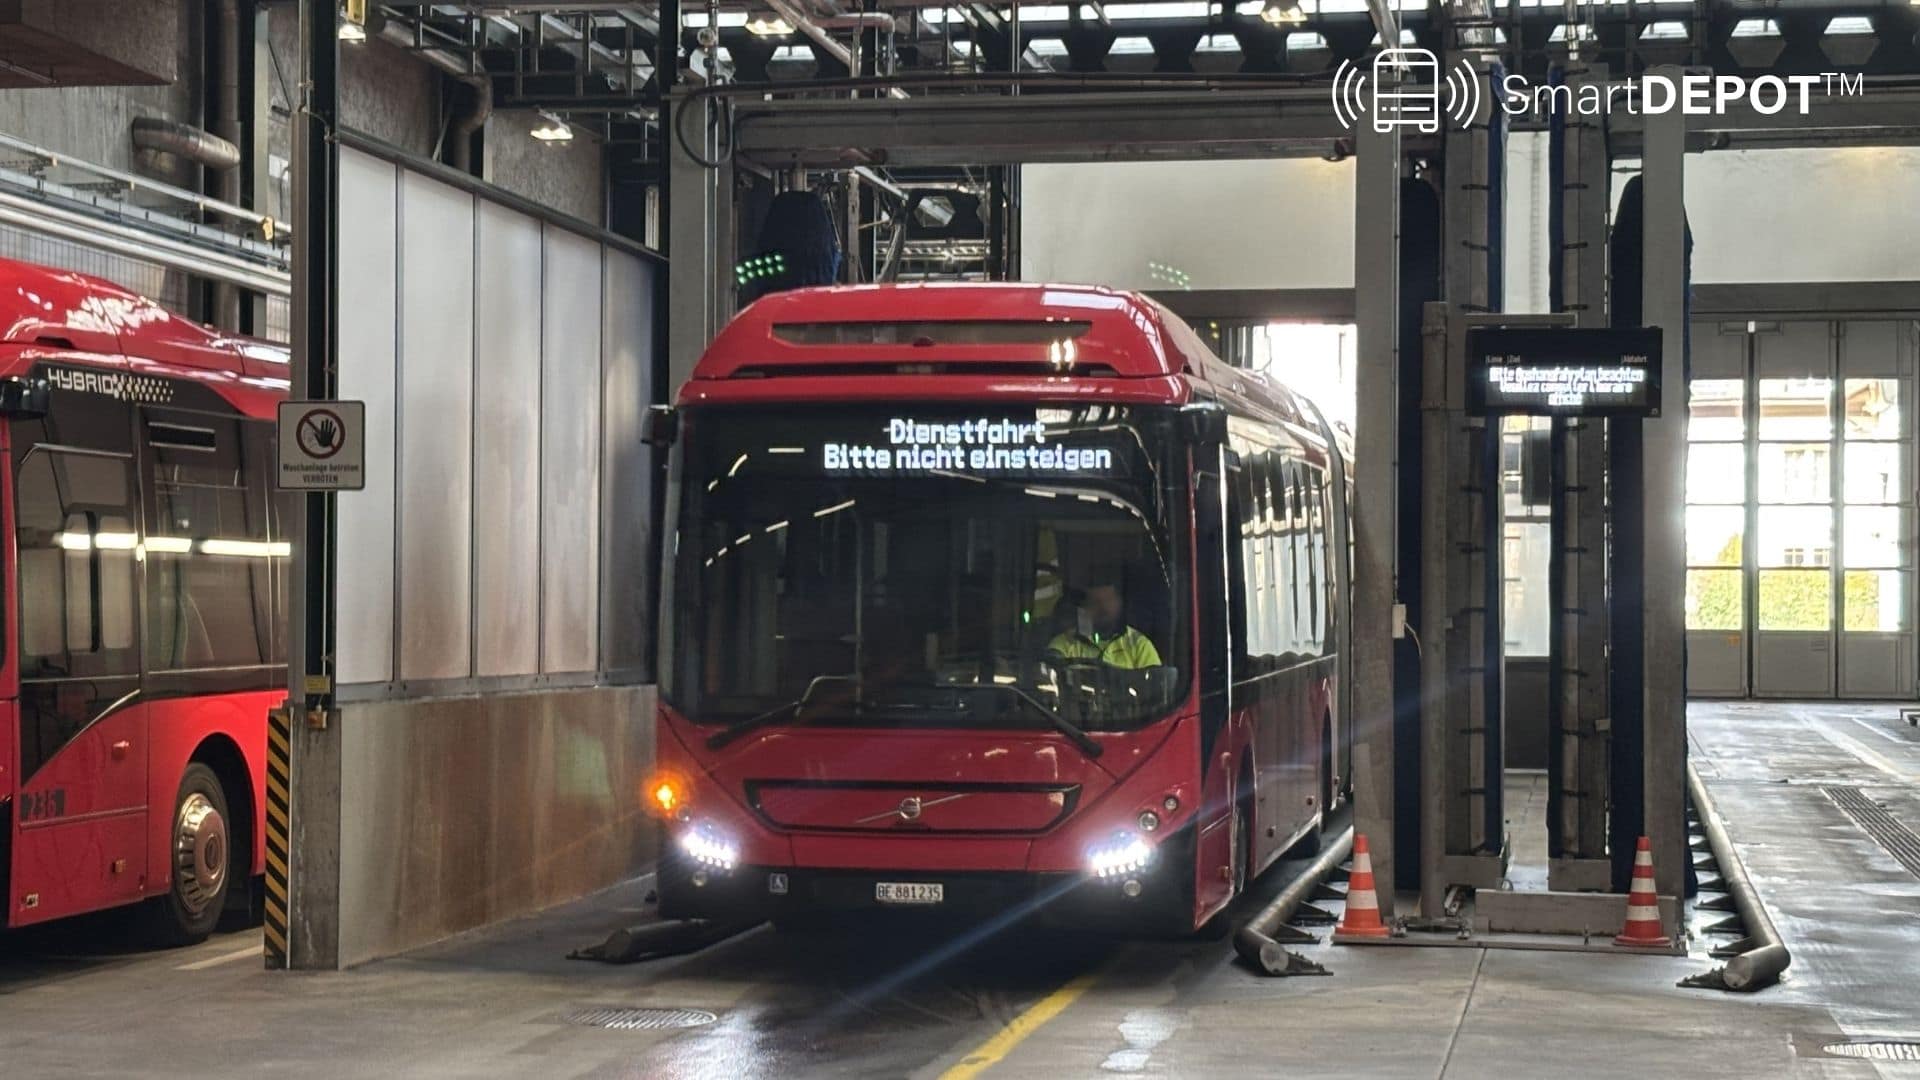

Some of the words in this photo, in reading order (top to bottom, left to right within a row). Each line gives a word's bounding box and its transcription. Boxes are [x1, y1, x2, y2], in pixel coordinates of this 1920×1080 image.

[48, 368, 114, 394] HYBRID
[889, 419, 1046, 444] Dienstfahrt
[824, 444, 891, 469] Bitte
[896, 444, 965, 469] nicht
[970, 444, 1112, 471] einsteigen
